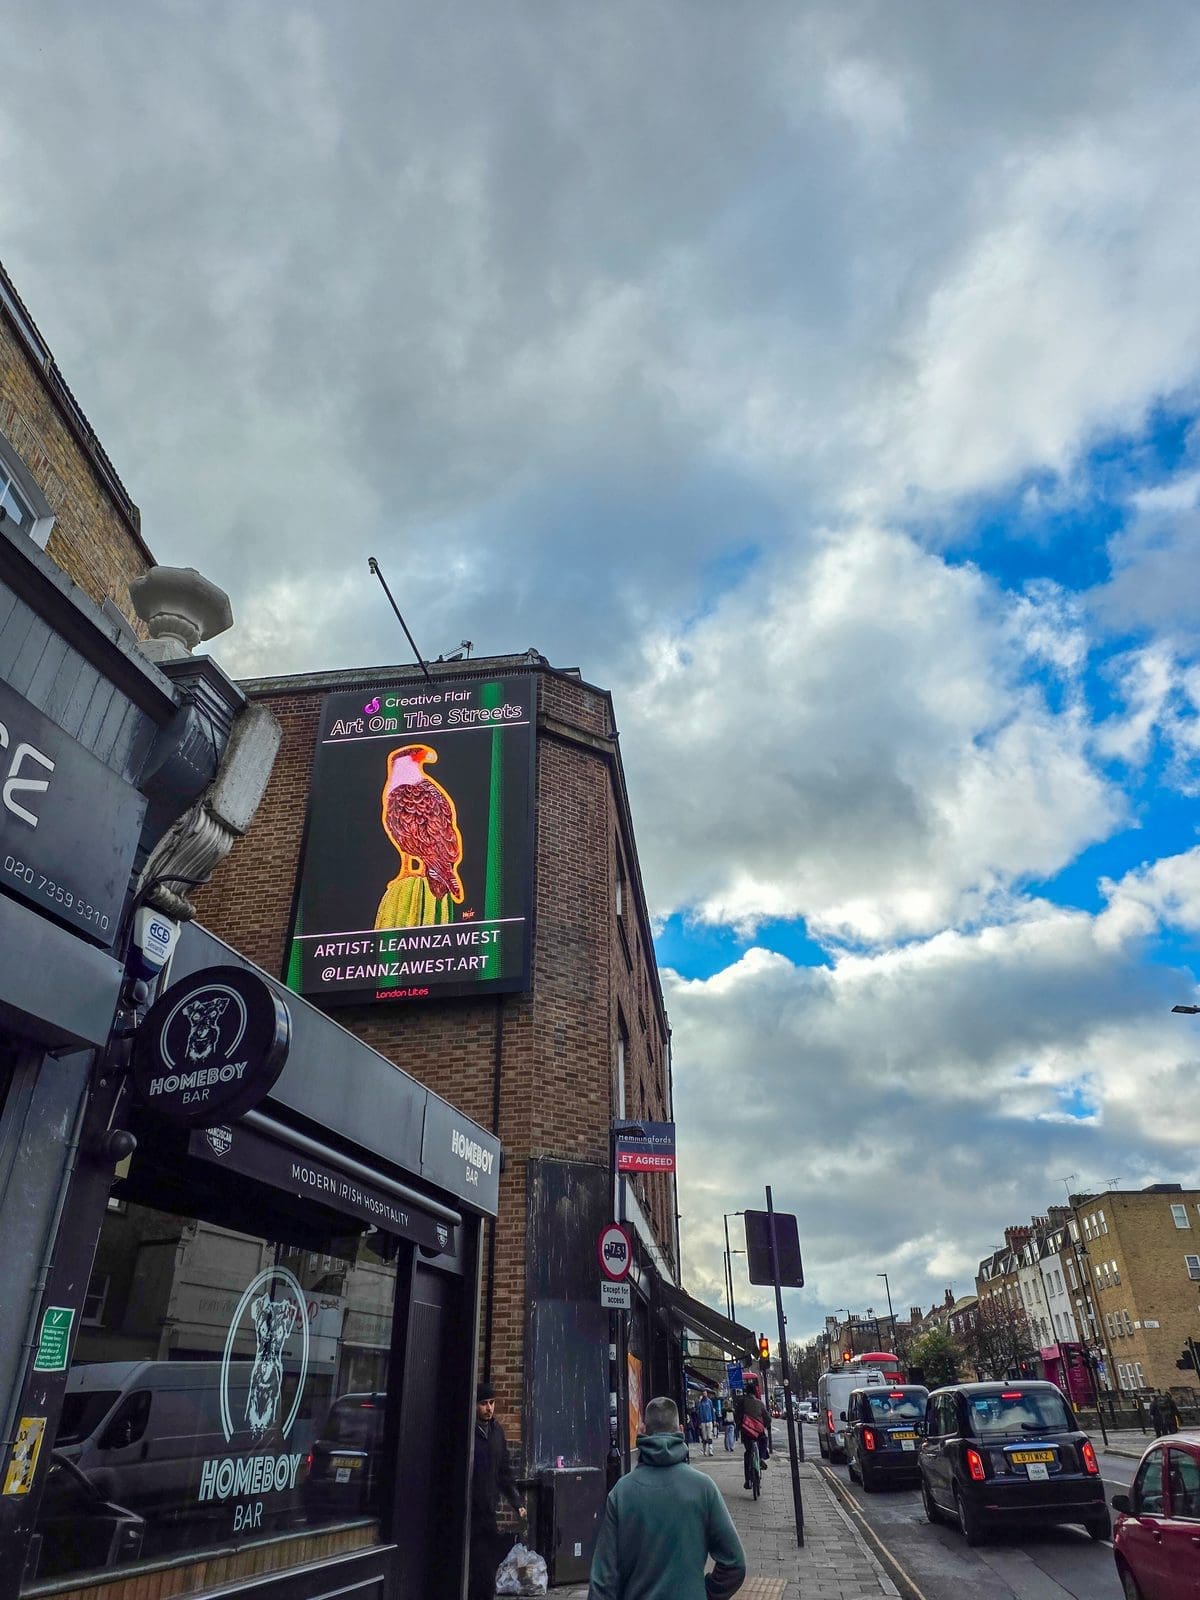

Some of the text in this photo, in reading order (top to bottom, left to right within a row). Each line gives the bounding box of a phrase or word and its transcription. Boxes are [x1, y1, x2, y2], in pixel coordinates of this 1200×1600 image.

[385, 690, 472, 708] Creative Flair
[330, 704, 522, 736] Art On The Streets
[4, 856, 109, 930] 020 7359 5310
[150, 923, 170, 943] ACE
[314, 930, 500, 958] ARTIST: LEANNZA WEST
[321, 955, 489, 981] @LEANNZAWEST.ART
[376, 988, 429, 999] London Lites
[150, 1061, 248, 1096] HOMEBOY
[182, 1089, 210, 1104] BAR
[452, 1129, 494, 1175] HOMEBOY
[636, 1157, 673, 1166] AGREED
[465, 1166, 479, 1187] BAR
[292, 1164, 409, 1226] MODERN IRISH HOSPITALITY
[603, 1285, 629, 1295] Except for
[198, 1453, 302, 1501] HOMEBOY
[233, 1502, 263, 1531] BAR
